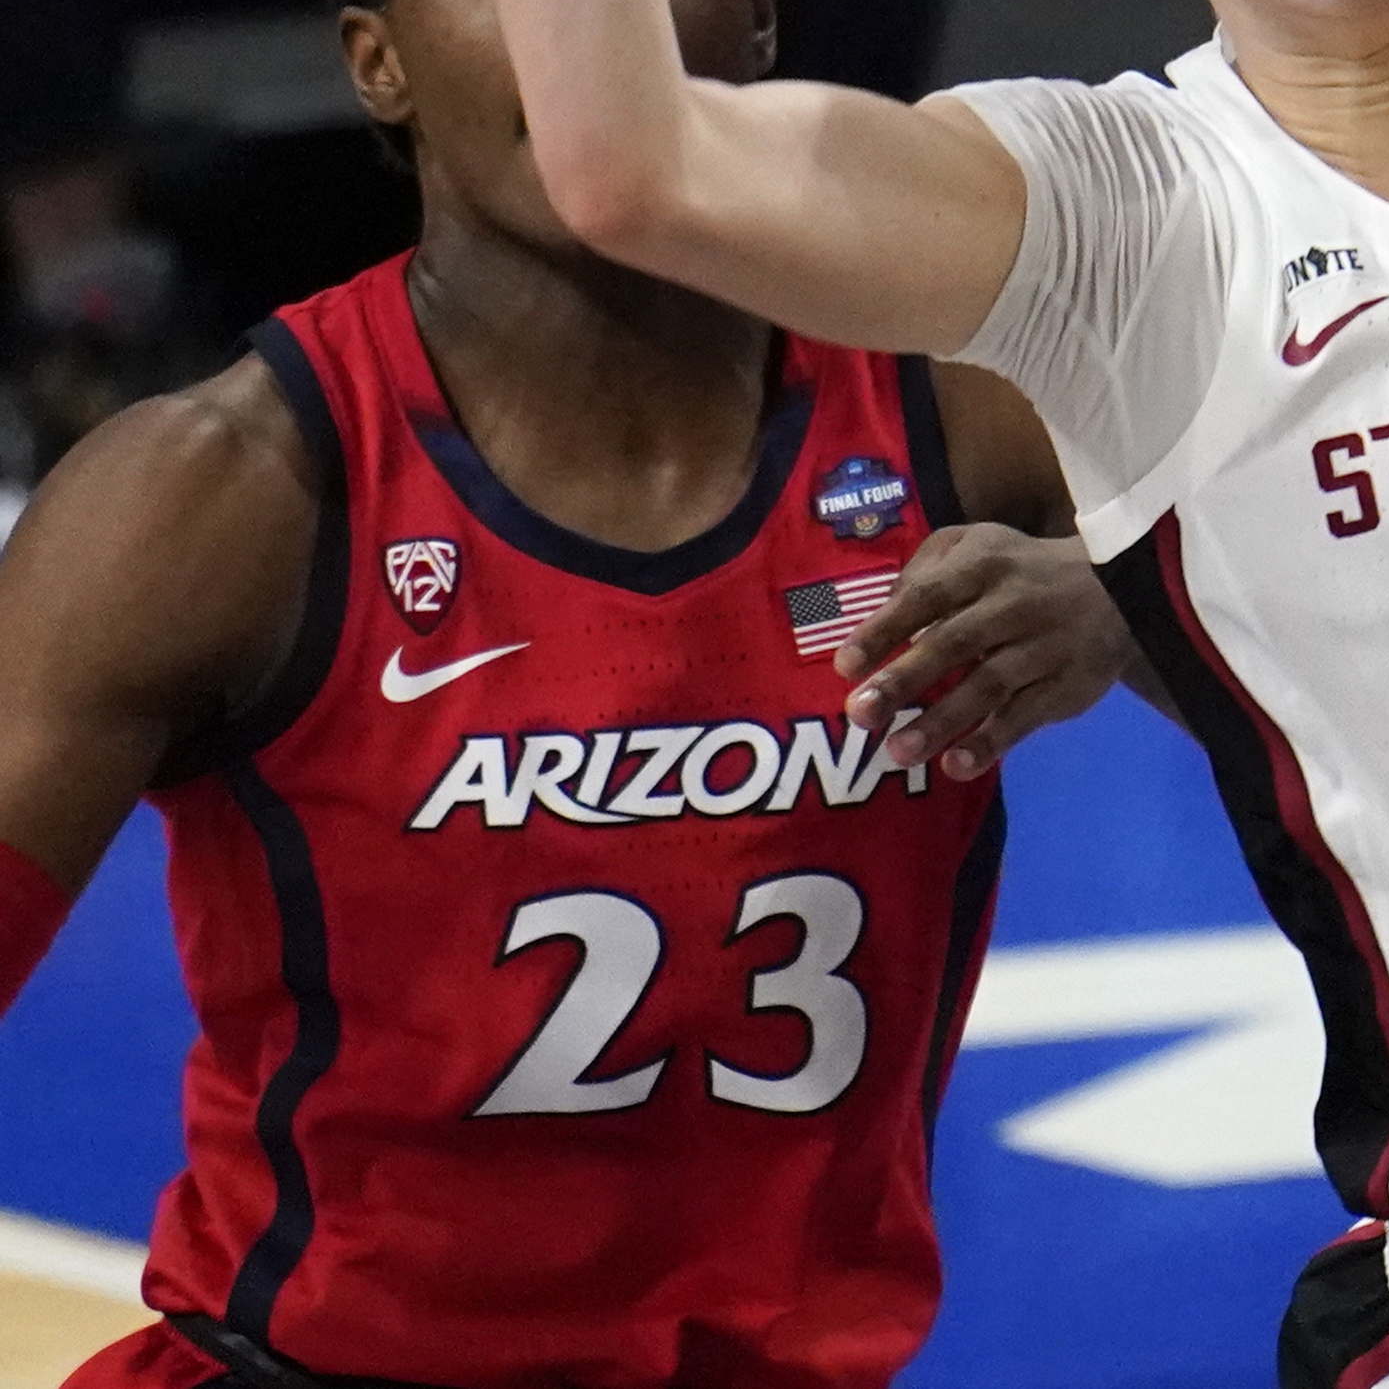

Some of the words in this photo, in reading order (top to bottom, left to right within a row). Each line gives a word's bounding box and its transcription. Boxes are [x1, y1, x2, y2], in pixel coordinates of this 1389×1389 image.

[820, 491, 862, 515] FINAL
[862, 480, 905, 504] FOUR
[386, 541, 457, 596] PAC
[404, 576, 441, 612] 12
[405, 706, 927, 831] ARIZONA
[466, 870, 869, 1119] 23
